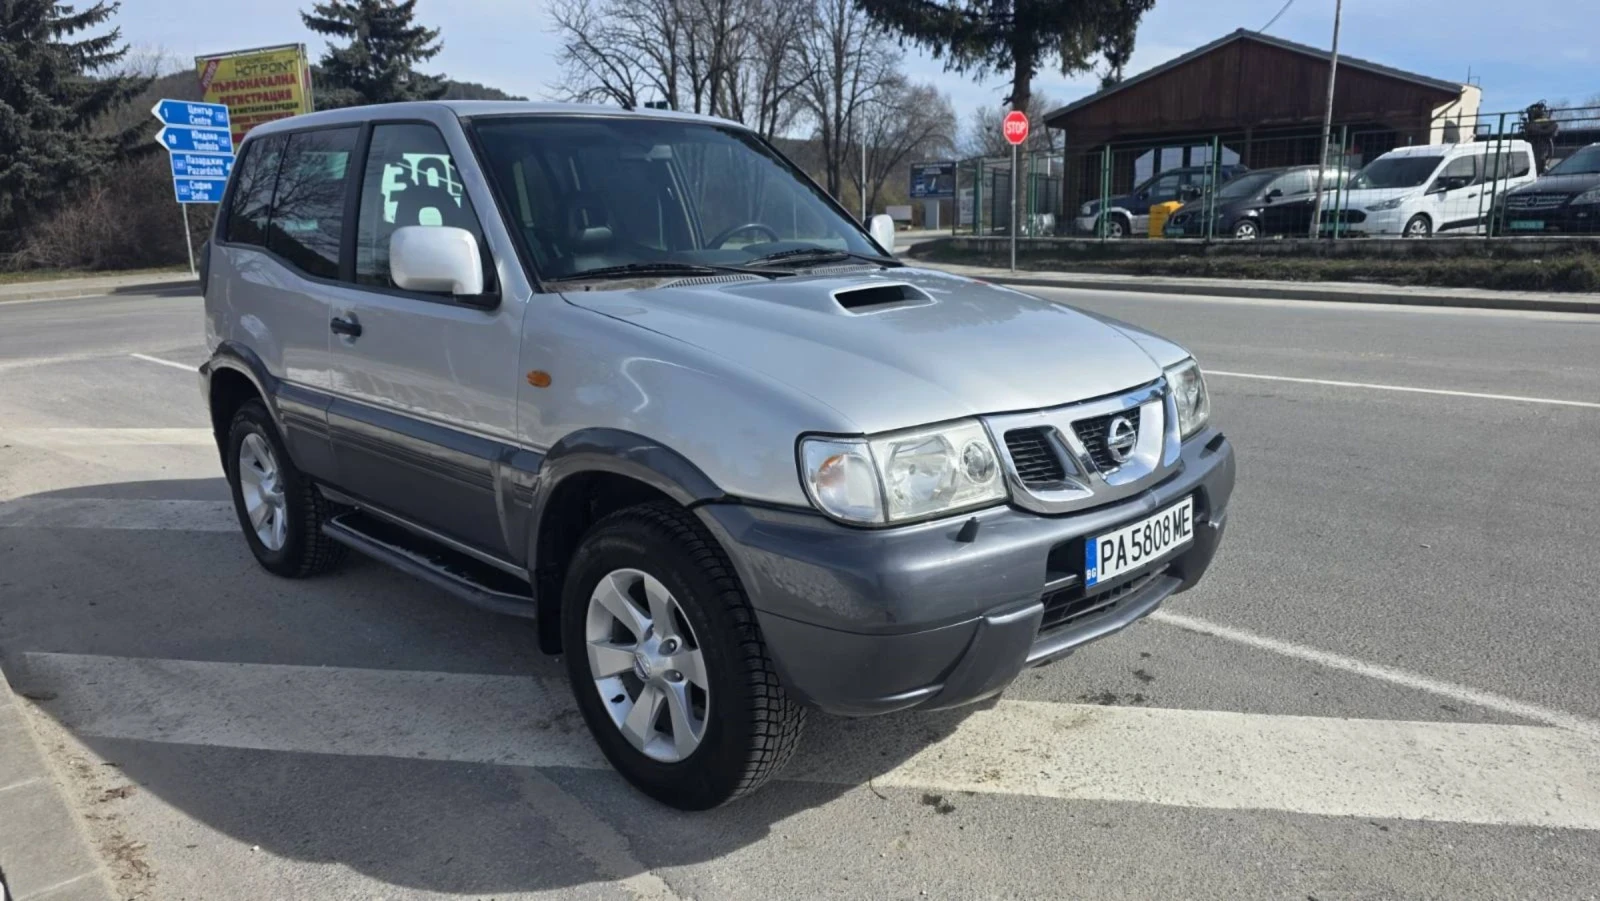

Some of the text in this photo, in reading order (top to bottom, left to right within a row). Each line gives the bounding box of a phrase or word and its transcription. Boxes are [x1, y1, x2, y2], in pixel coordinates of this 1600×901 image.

[187, 104, 213, 117] Център
[189, 114, 212, 126] Centre
[1006, 121, 1026, 135] STOP
[187, 165, 224, 175] Pazardzhik
[189, 180, 213, 191] София
[191, 190, 209, 200] Sofia
[1086, 568, 1096, 580] BG
